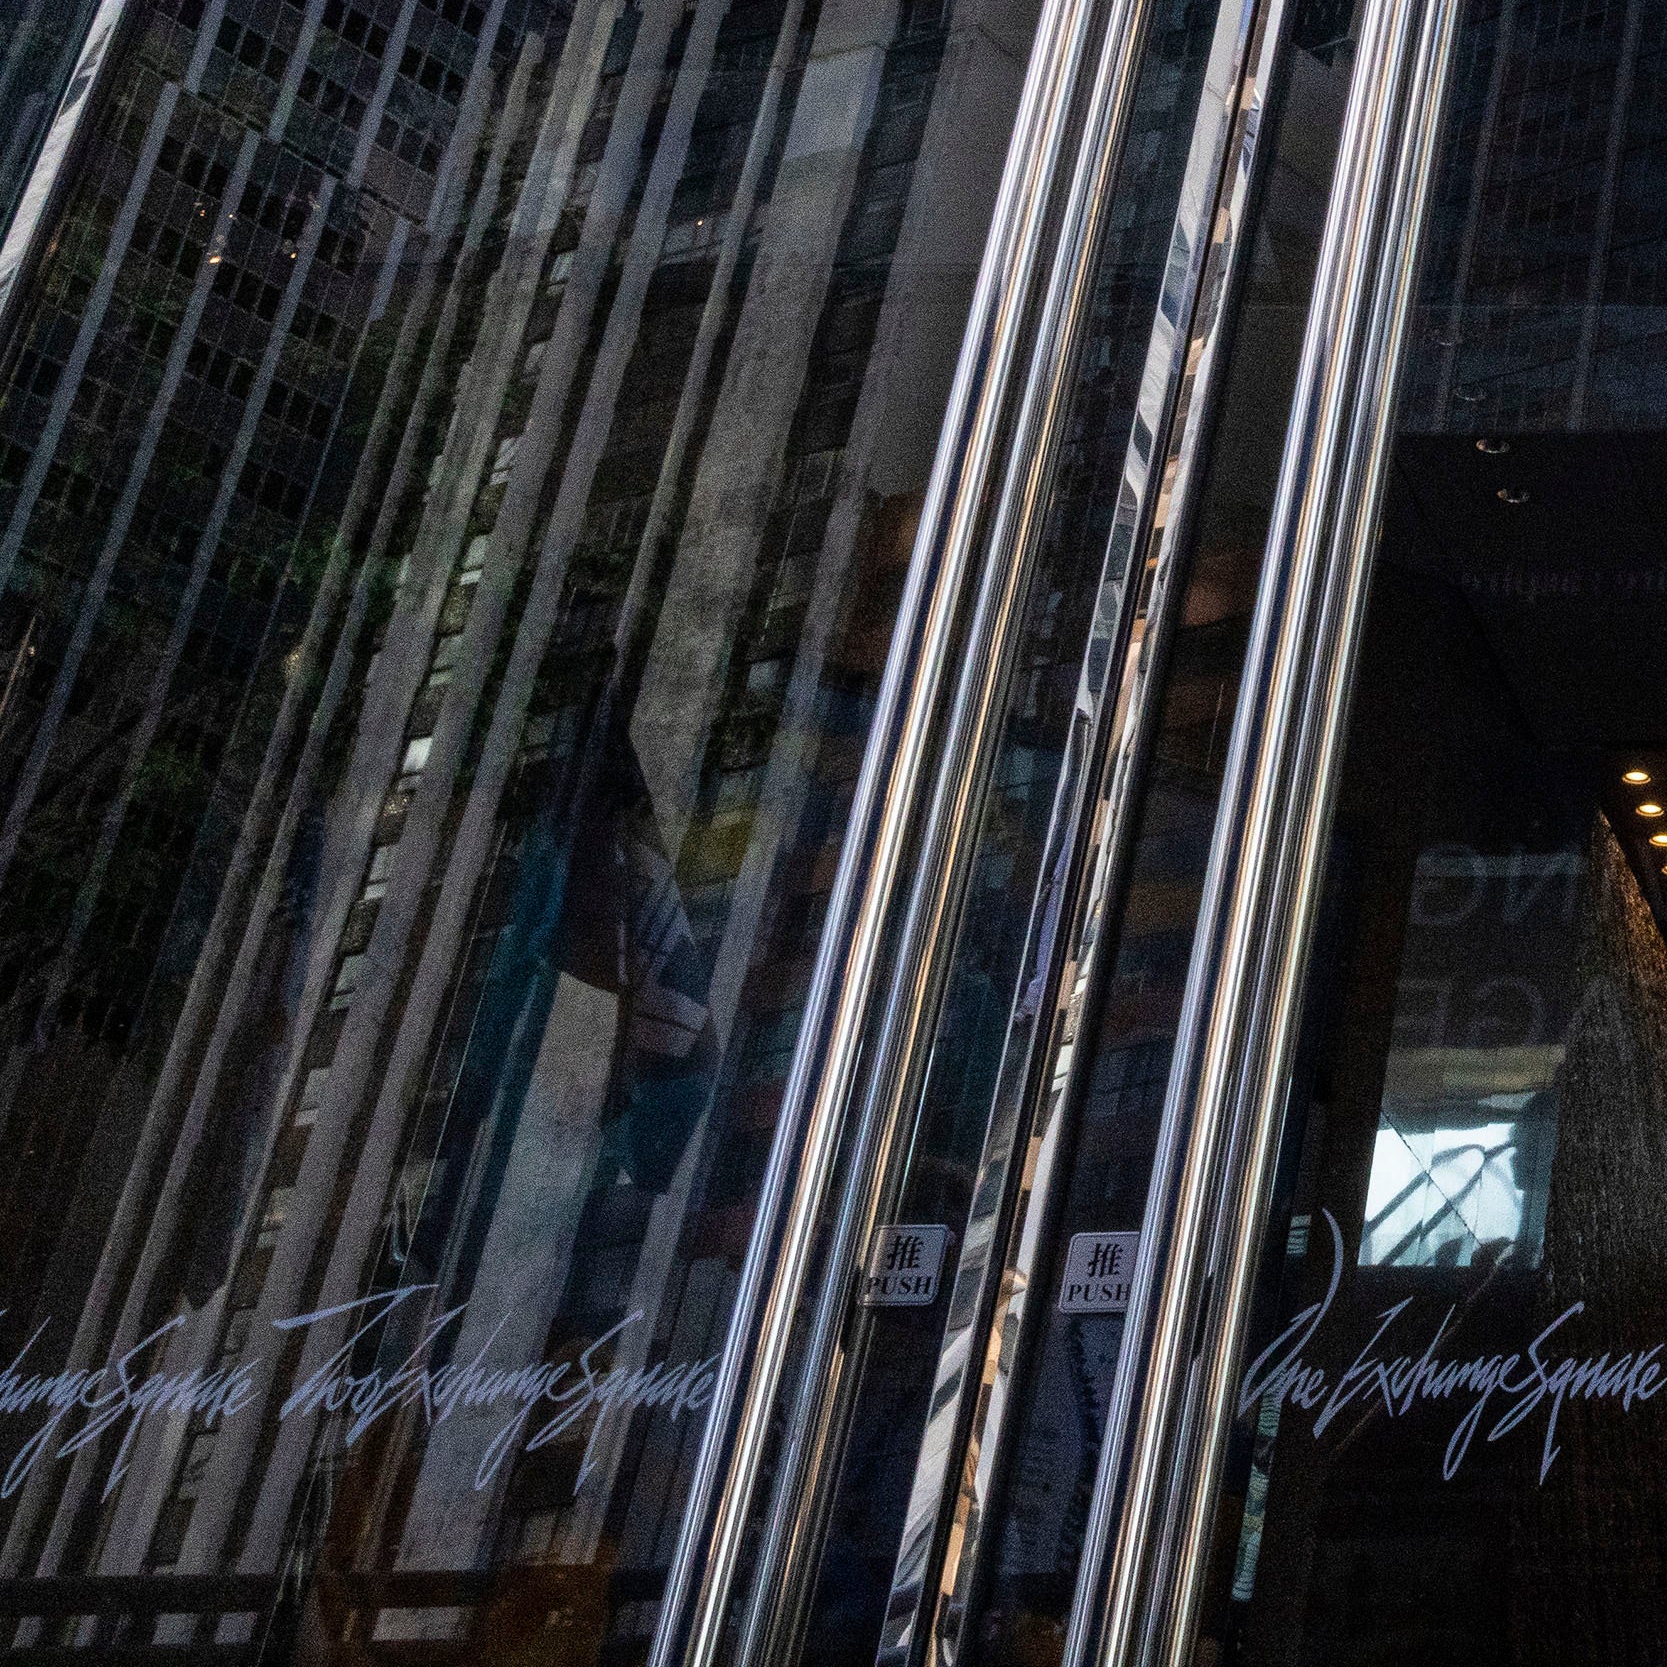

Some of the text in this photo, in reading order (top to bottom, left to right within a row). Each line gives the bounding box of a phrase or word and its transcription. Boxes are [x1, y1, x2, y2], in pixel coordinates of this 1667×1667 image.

[886, 1235, 925, 1271] 推
[1086, 1243, 1124, 1279] 推
[866, 1275, 934, 1297] PUSH
[1066, 1282, 1132, 1303] PUSH
